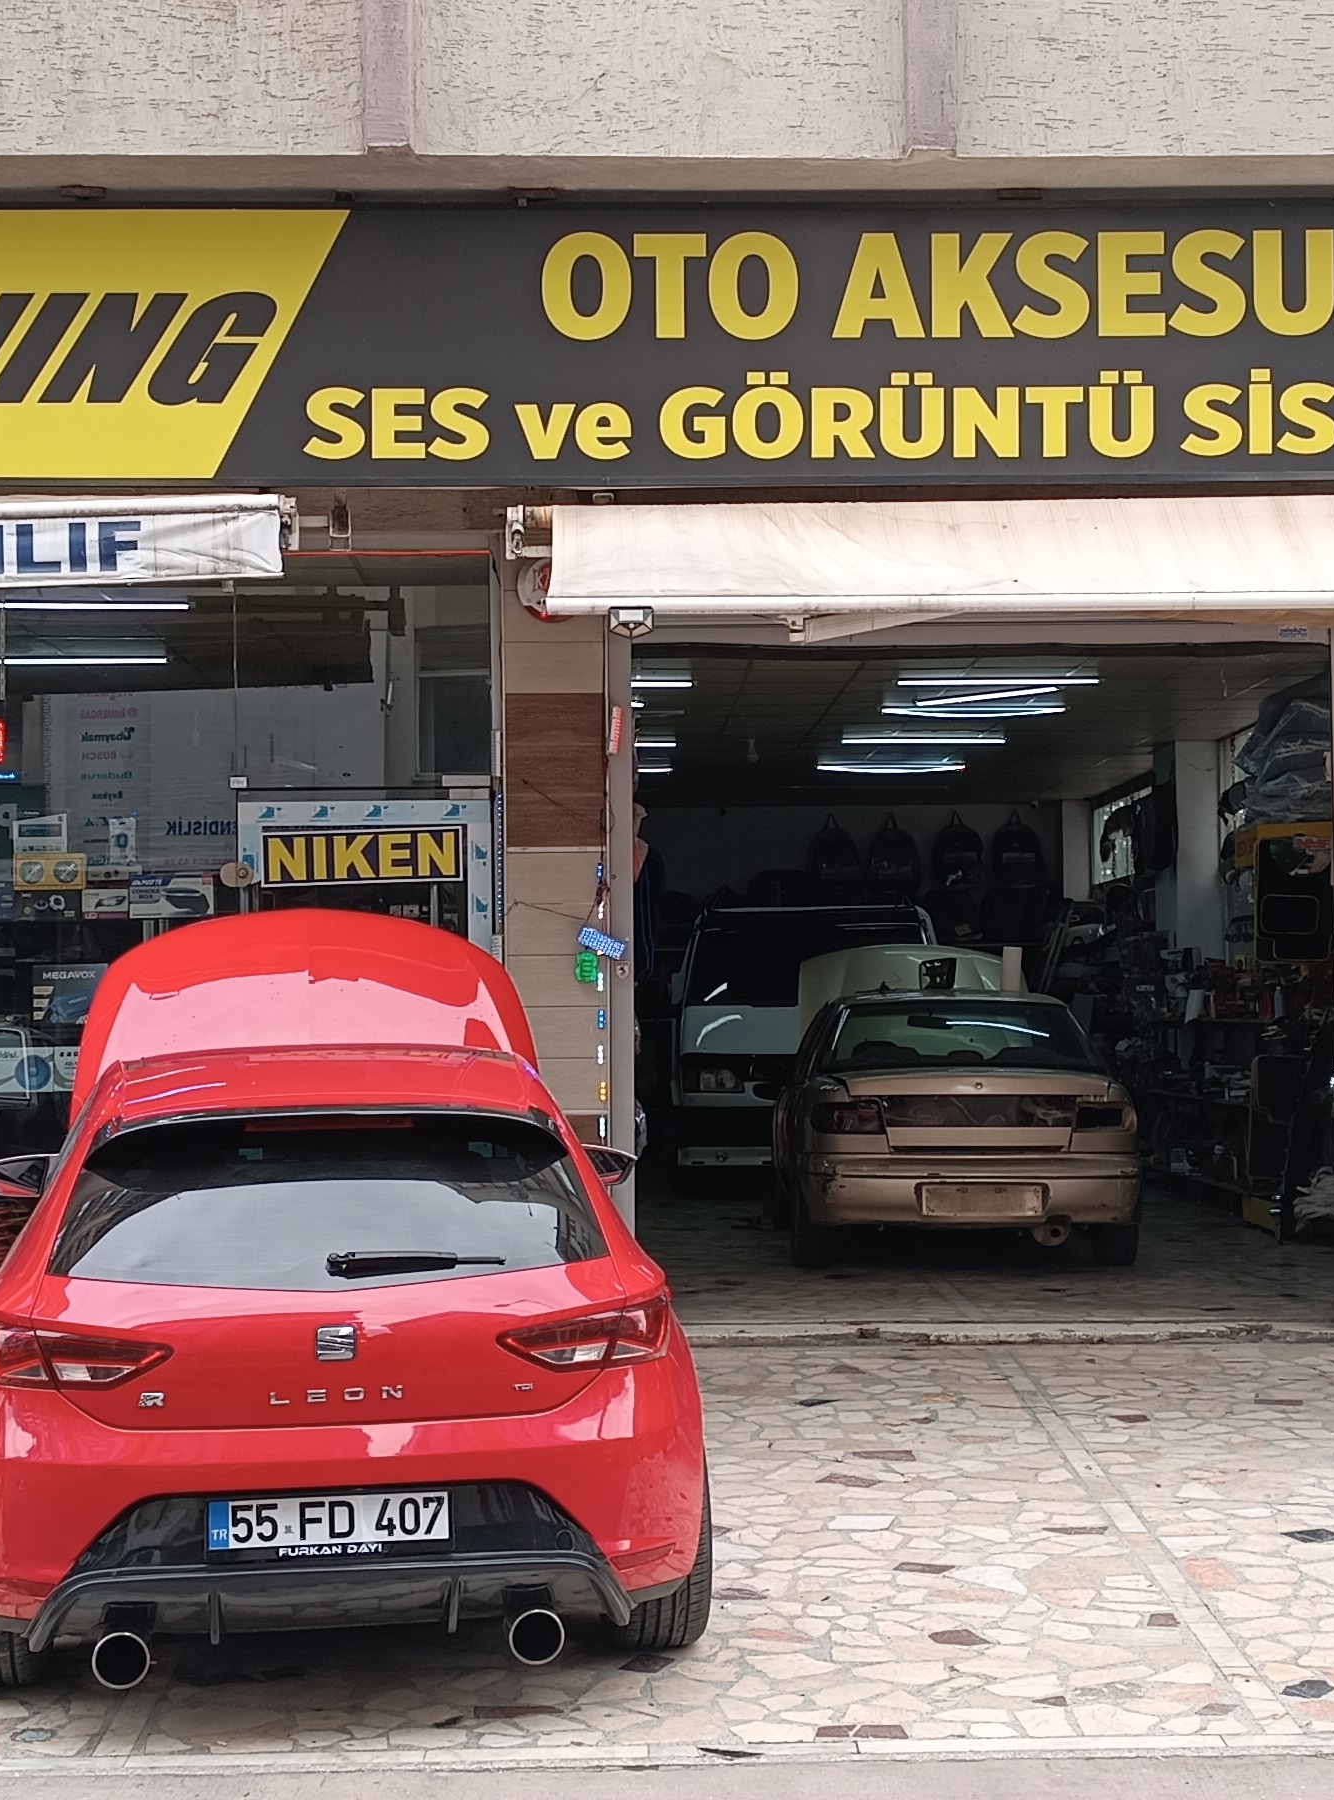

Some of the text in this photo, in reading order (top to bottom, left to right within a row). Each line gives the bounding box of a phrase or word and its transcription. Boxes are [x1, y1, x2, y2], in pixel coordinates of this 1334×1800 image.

[540, 231, 800, 341] OTO
[302, 386, 490, 461] SES
[514, 402, 632, 461] ve
[659, 370, 1155, 460] GÖRÜNTÜ
[267, 831, 456, 882] NIKEN
[42, 970, 96, 980] MEGAVOX
[270, 1385, 403, 1405] LEON
[212, 1496, 445, 1543] TR 55 FD 407
[278, 1543, 383, 1557] FURKAN DAYI
